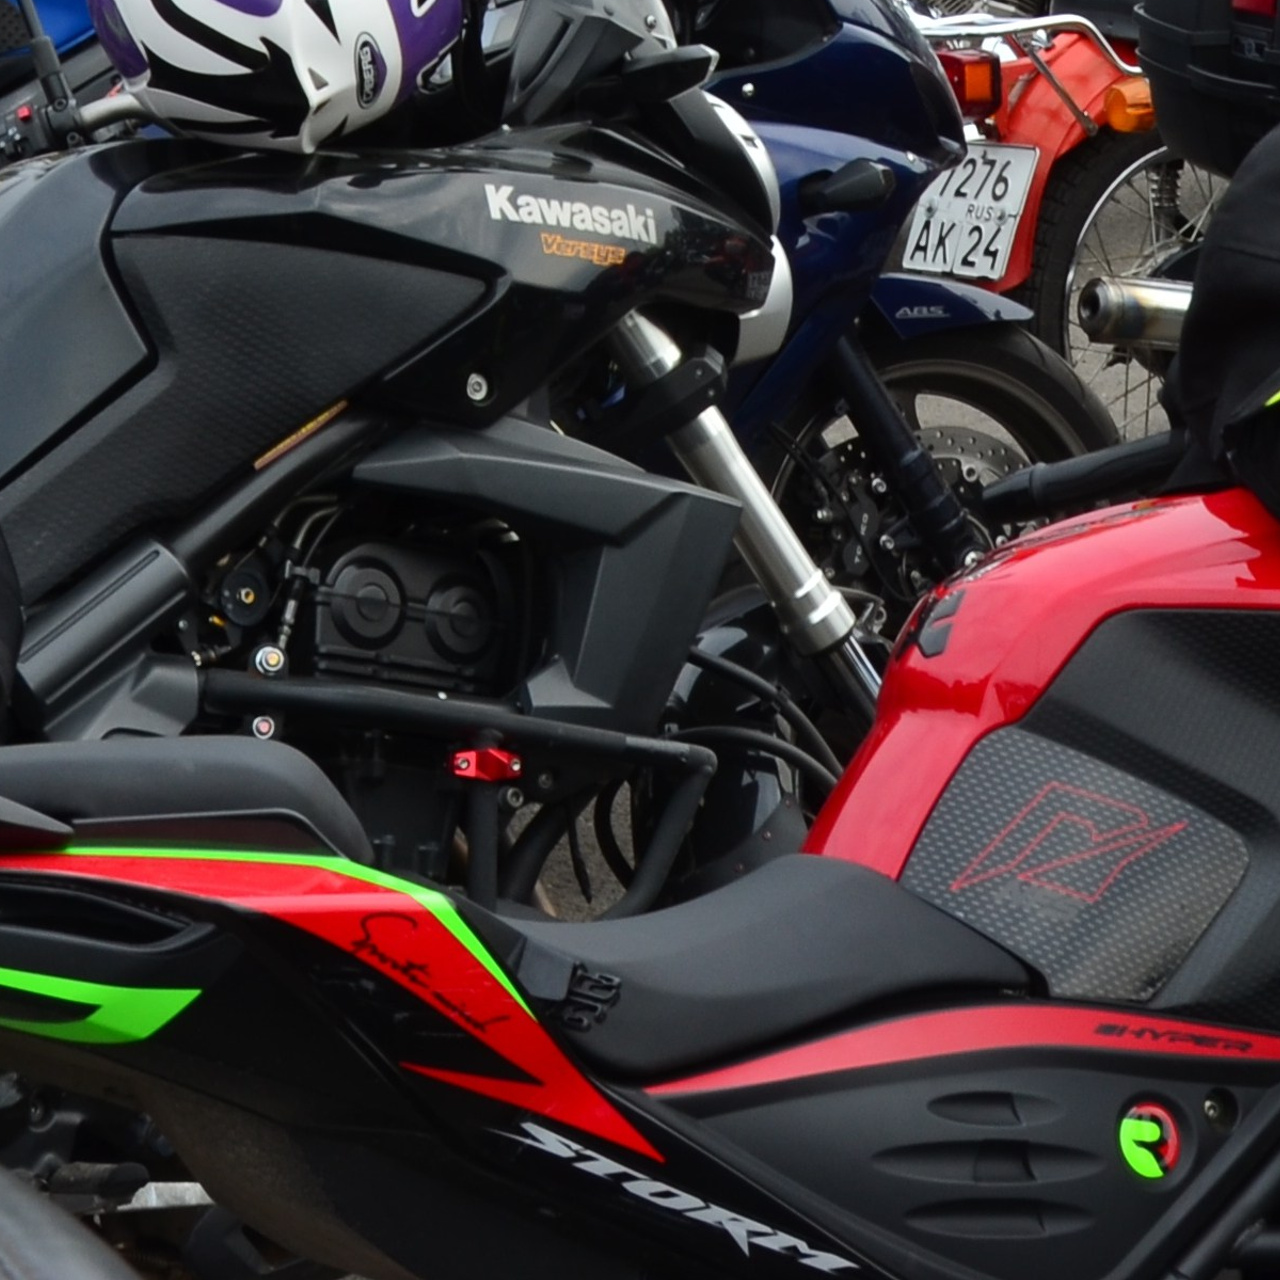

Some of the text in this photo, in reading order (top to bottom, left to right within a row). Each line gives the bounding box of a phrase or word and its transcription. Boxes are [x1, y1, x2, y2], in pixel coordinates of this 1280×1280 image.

[484, 183, 658, 245] Kawasaki
[965, 203, 994, 221] RUS
[960, 225, 1001, 271] 24
[497, 1121, 862, 1277] STORM
